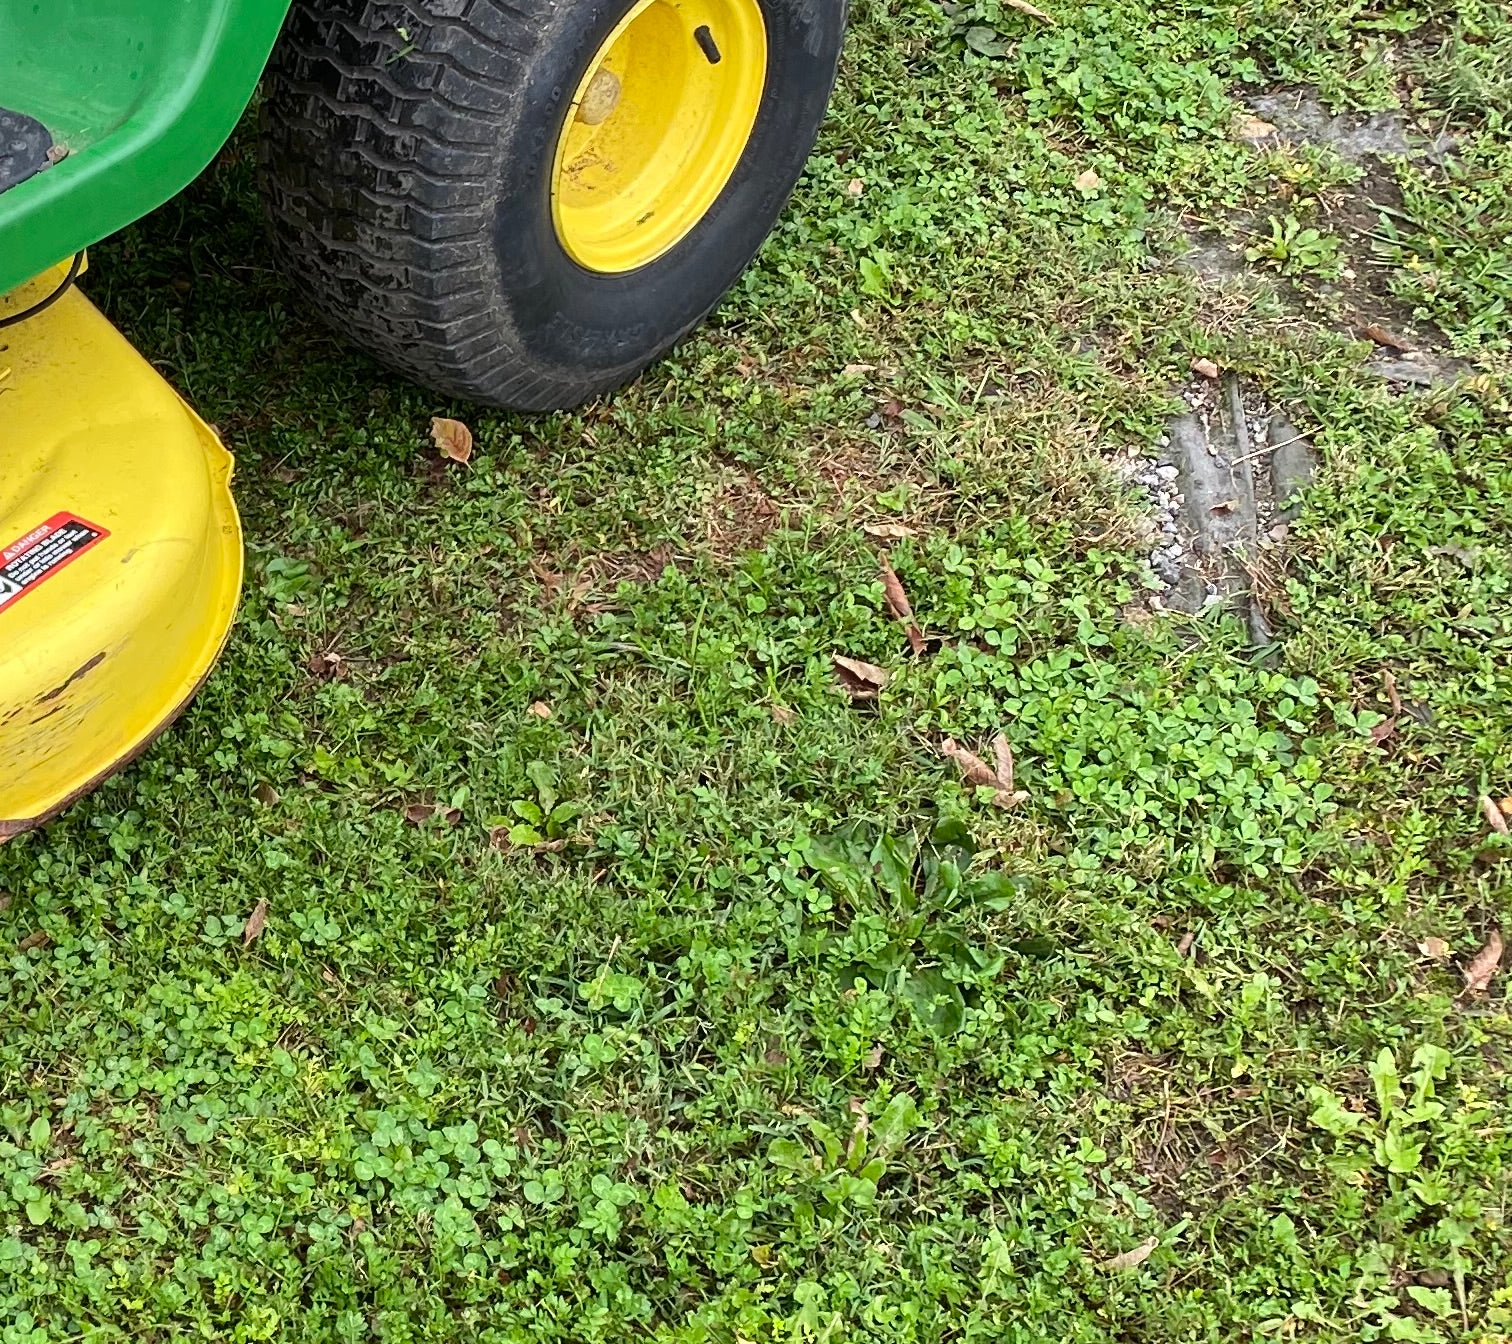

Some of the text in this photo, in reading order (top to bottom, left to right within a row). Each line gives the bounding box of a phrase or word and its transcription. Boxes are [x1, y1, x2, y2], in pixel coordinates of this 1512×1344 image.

[5, 528, 67, 571] ROTATING BLADE
[10, 525, 51, 552] DANGER
